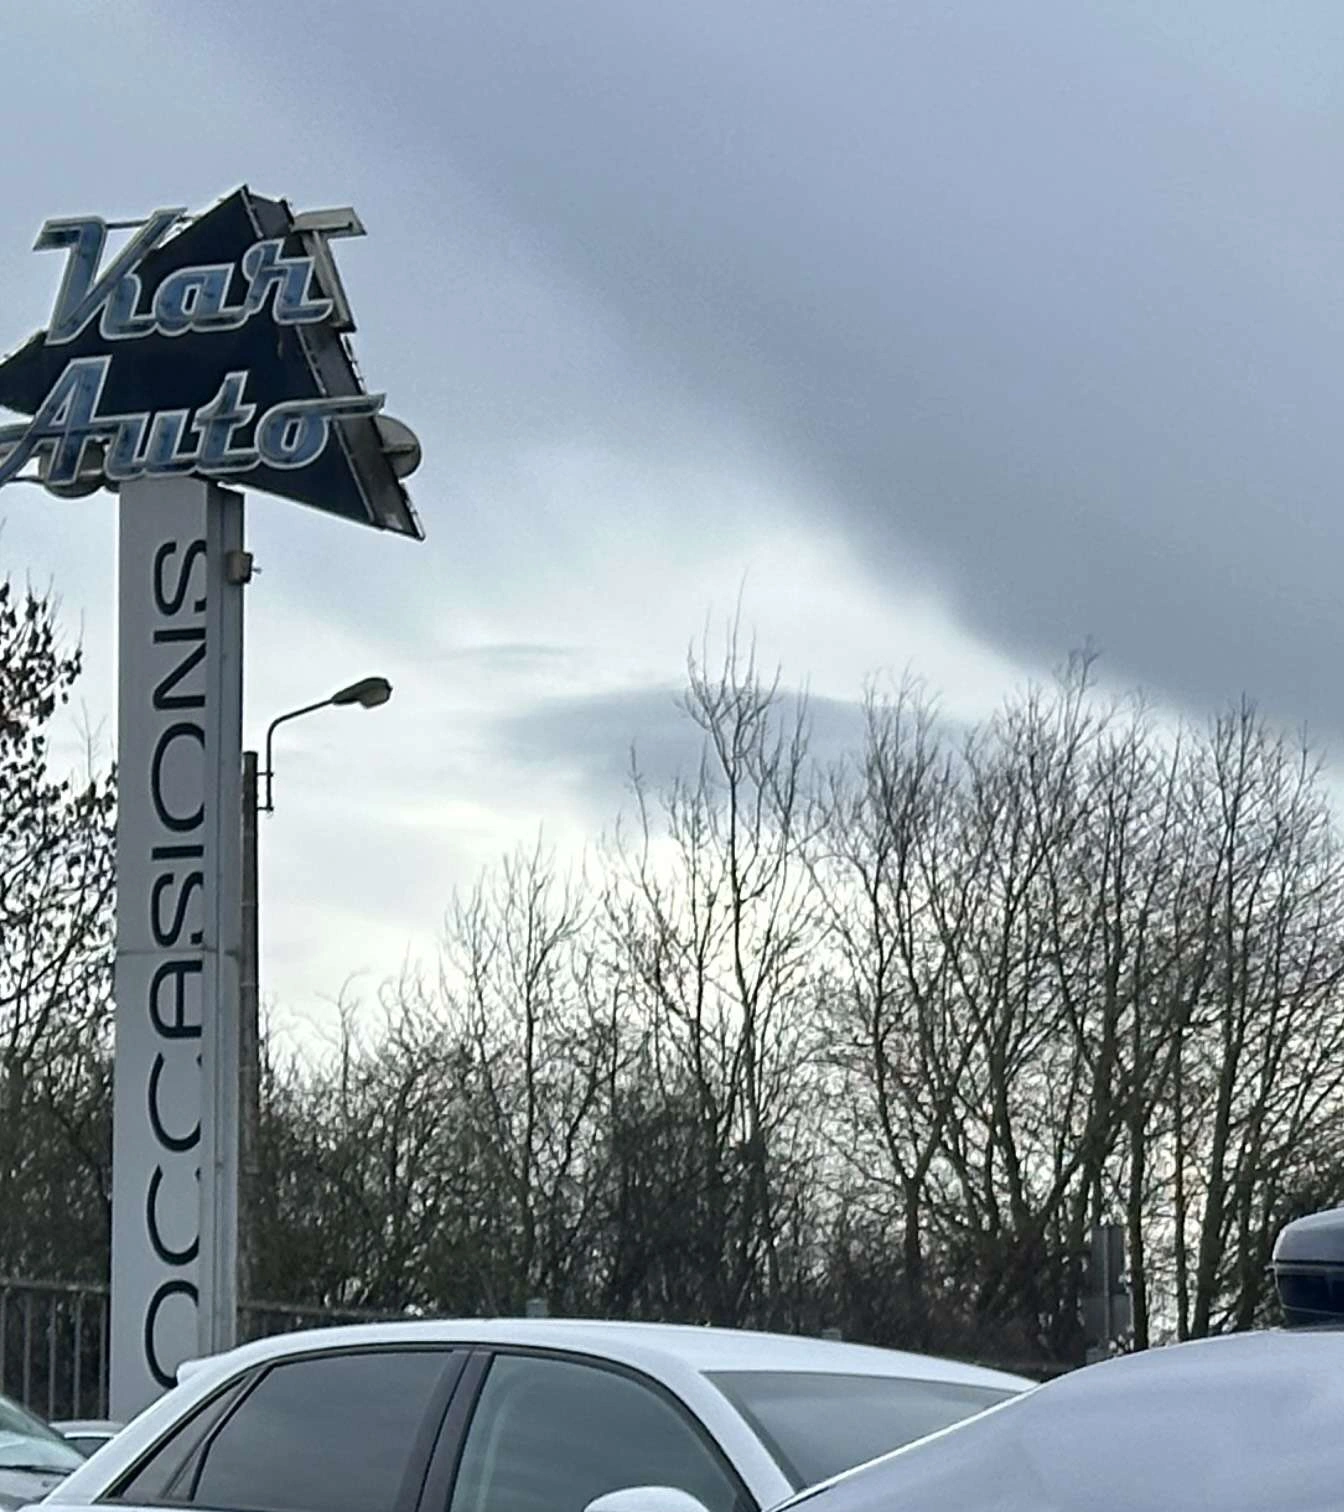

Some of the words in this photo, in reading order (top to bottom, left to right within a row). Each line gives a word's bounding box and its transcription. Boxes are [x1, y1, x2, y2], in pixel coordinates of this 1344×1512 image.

[32, 207, 334, 347] Kar
[0, 354, 387, 486] Auto
[144, 539, 208, 1390] OCCASIONS
